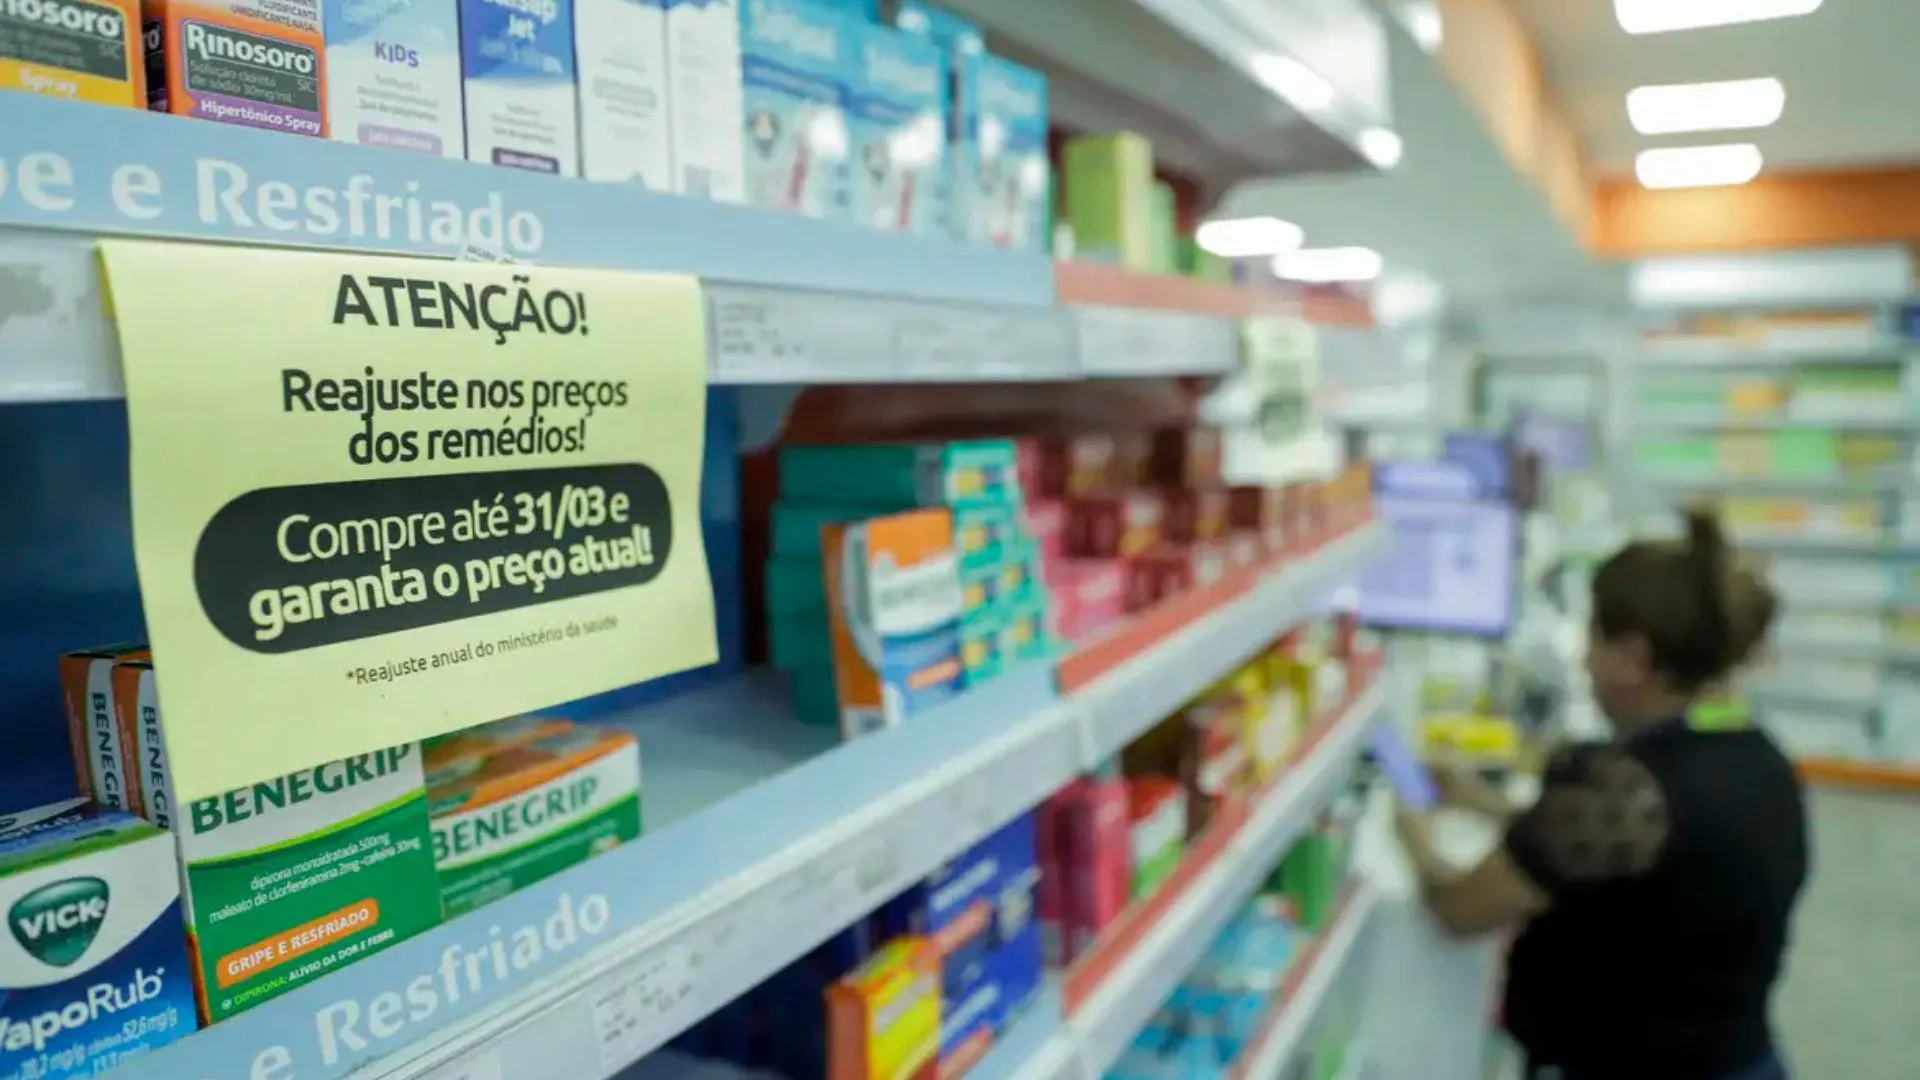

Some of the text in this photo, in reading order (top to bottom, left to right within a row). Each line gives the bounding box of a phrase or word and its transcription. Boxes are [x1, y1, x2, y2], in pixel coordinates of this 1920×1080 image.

[187, 24, 313, 73] Rinosoro
[374, 40, 420, 68] KIDS
[201, 99, 321, 134] Hipertônico Spray
[0, 152, 544, 252] e e Resfriado
[332, 273, 590, 345] ATENÇÃO!
[281, 366, 630, 420] Reajuste nos preços
[348, 415, 587, 465] dos remédios!
[276, 484, 630, 562] Compre até 31/03 e
[248, 523, 655, 641] garanta o preço atual!
[430, 644, 474, 668] anual
[476, 641, 494, 659] do
[497, 627, 563, 654] ministério
[565, 619, 582, 639] da
[582, 615, 619, 634] saúde
[189, 742, 411, 835] BENEGRIP
[18, 896, 103, 940] VICK
[209, 898, 253, 924] maleato
[254, 892, 268, 907] de
[227, 907, 370, 976] GRIPE E RESFRIADO
[323, 952, 338, 966] DA
[315, 891, 609, 1067] Resfriado
